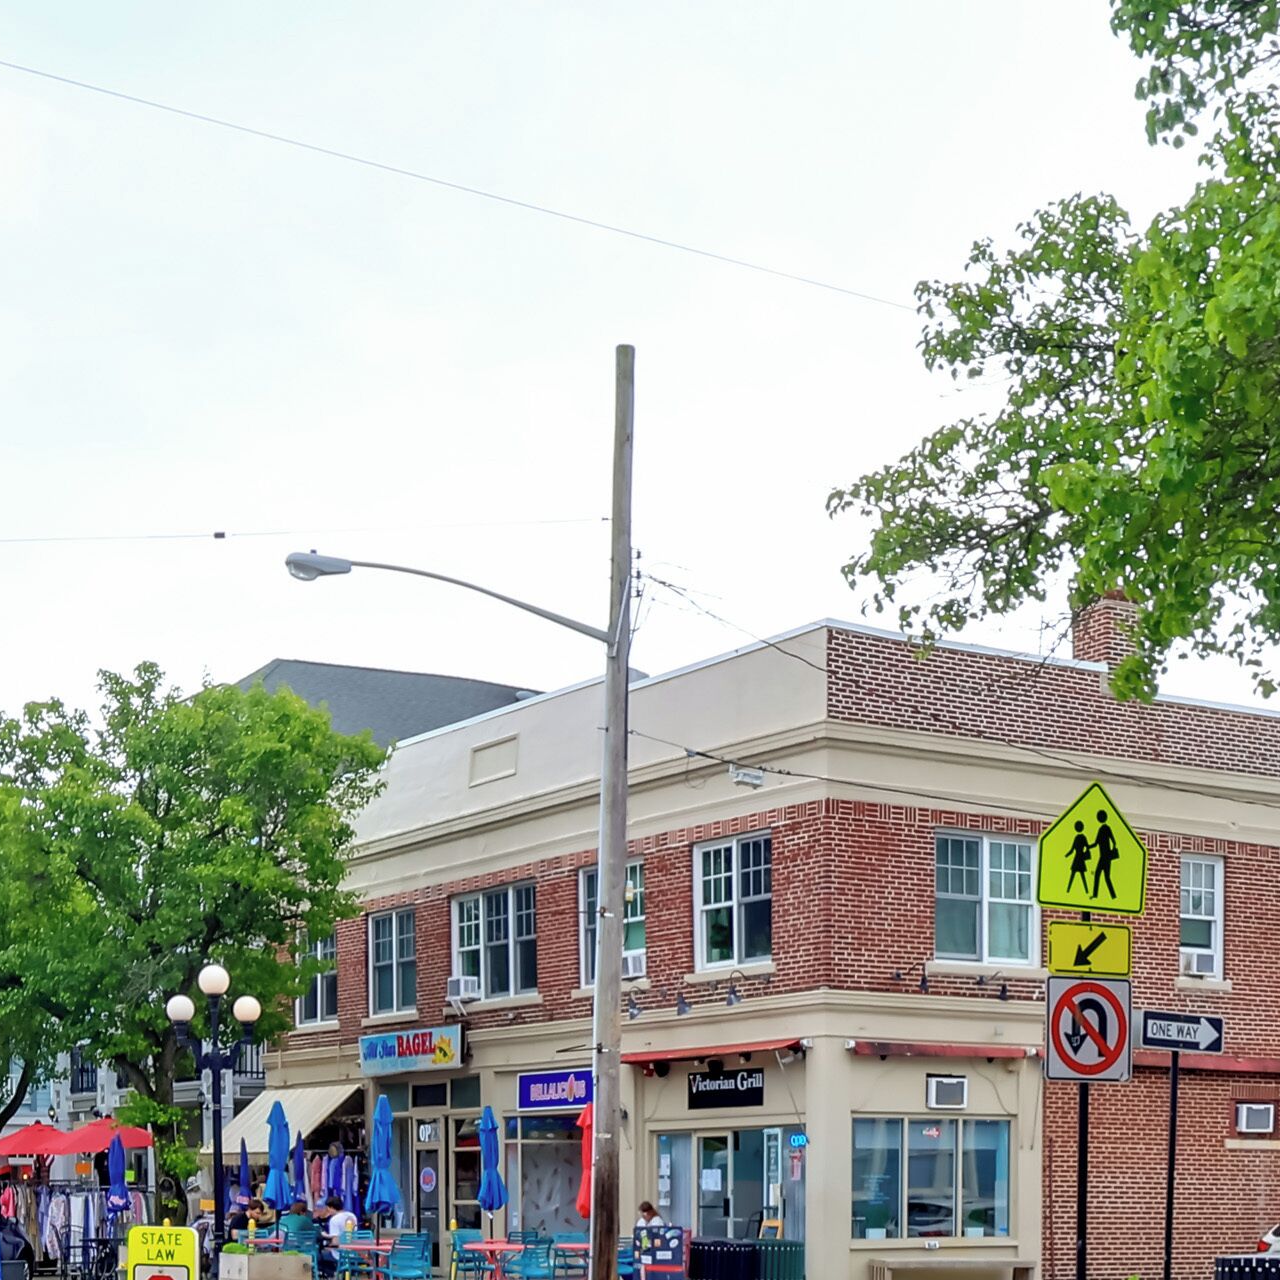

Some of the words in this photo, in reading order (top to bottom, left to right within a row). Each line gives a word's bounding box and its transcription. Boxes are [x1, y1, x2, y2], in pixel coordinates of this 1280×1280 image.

[1151, 1022, 1173, 1037] ONE
[1176, 1025, 1200, 1040] WAY
[396, 1031, 436, 1057] BAGEL
[689, 1074, 735, 1093] Victorian
[737, 1071, 763, 1090] Grill
[141, 1232, 182, 1246] STATE
[147, 1249, 175, 1261] LAW
